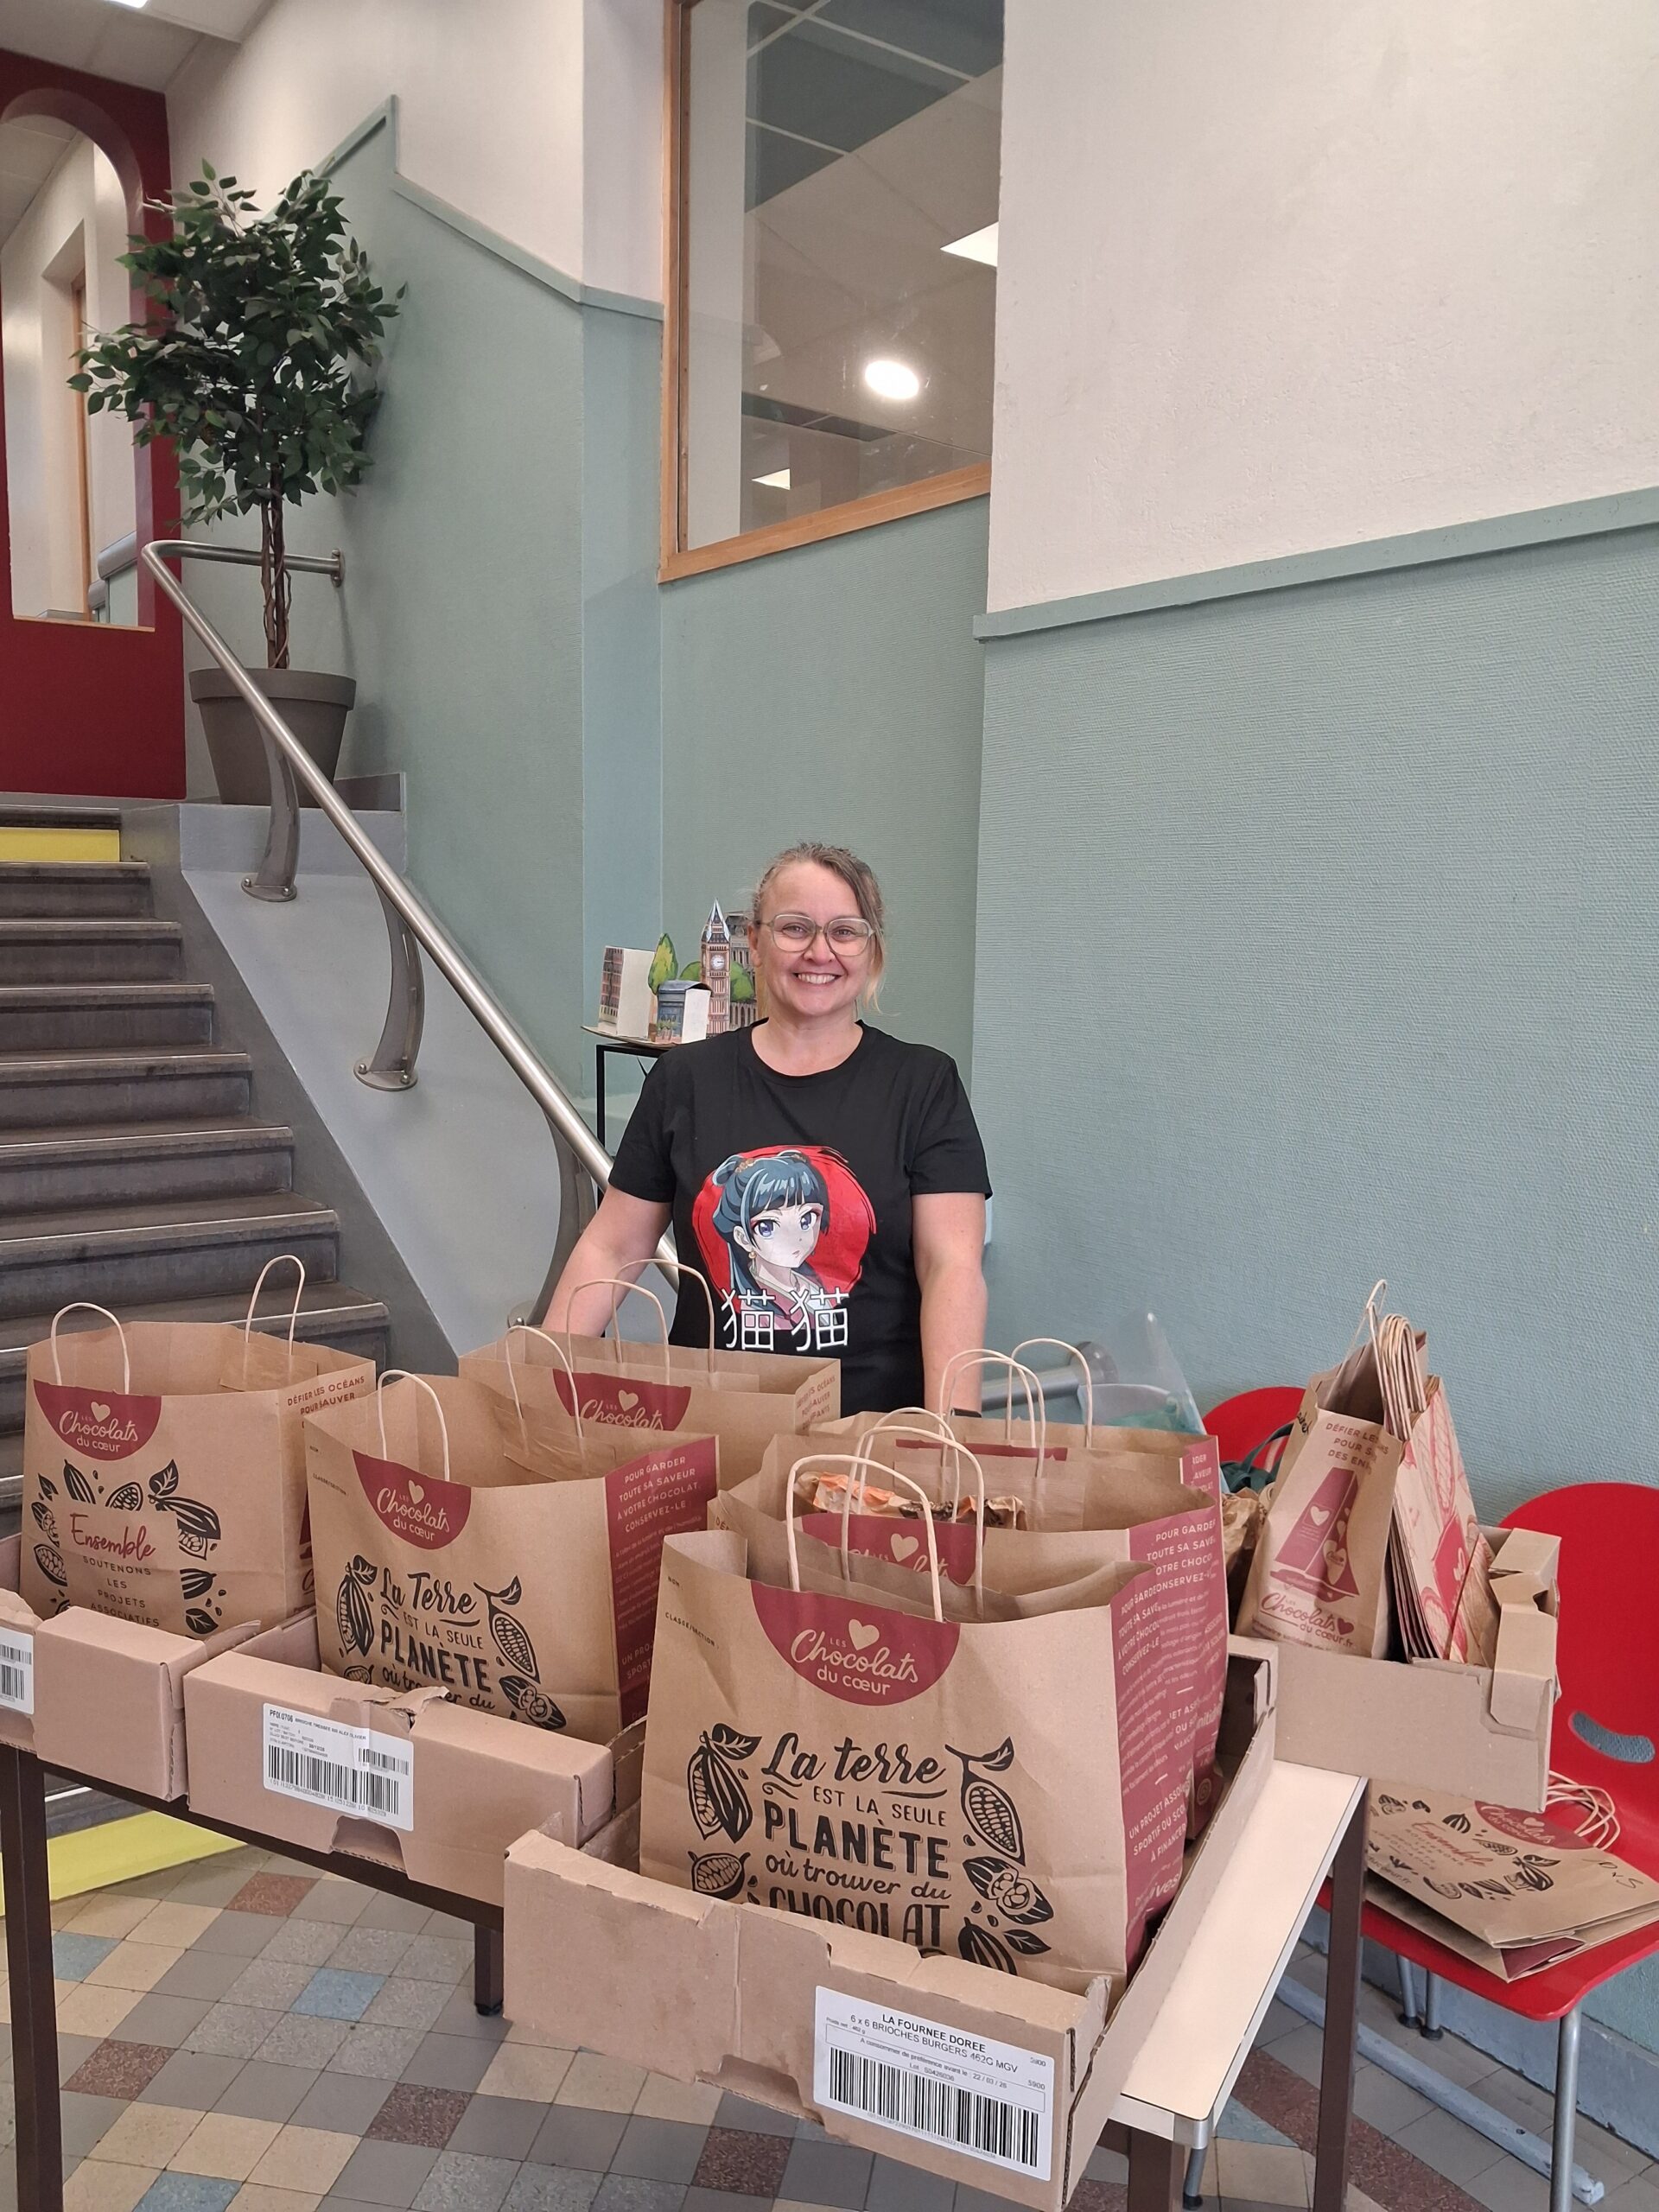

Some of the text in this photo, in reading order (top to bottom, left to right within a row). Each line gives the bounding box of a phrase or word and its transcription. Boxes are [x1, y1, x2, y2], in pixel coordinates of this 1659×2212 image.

[721, 1287, 849, 1351] 猫猫
[287, 1376, 365, 1406] DÉFIER LES OCÉANS
[300, 1392, 355, 1415] POUR SAUVER
[60, 1410, 138, 1442] Chocolats
[581, 1399, 664, 1431] Chocolats
[1325, 1422, 1361, 1438] DÉFIER
[76, 1436, 121, 1452] du cœur
[1328, 1450, 1348, 1461] DES
[1333, 1438, 1363, 1452] POUR
[619, 1468, 696, 1503] TOUTE SA SAVEUR
[625, 1456, 686, 1484] POUR GARDER
[377, 1487, 449, 1533] Chocolats
[623, 1499, 646, 1517] VOTRE
[625, 1500, 686, 1533] CONSERVEZ-LE
[70, 1512, 156, 1560] Ensemble
[393, 1516, 435, 1541] du cœur
[1155, 1529, 1179, 1542] POUR
[1147, 1535, 1217, 1561] TOUTE SA SAVE
[83, 1555, 151, 1575] SOUTENONS
[1155, 1561, 1179, 1576] OTRE
[97, 1589, 145, 1608] PROJETS
[106, 1578, 127, 1589] LES
[380, 1567, 478, 1615] La Terre
[91, 1603, 159, 1627] ASSOCIATIFS
[1262, 1592, 1335, 1631] Chocolats
[1300, 1622, 1313, 1633] du
[404, 1611, 484, 1650] EST LA SEULE
[830, 1637, 847, 1648] LES
[380, 1618, 493, 1693] PLANÈTE
[791, 1629, 918, 1683] Chocolats
[382, 1663, 401, 1687] où
[469, 1694, 496, 1710] du
[817, 1665, 891, 1695] du cœur
[761, 1732, 947, 1788] La terre
[813, 1785, 947, 1827] EST LA SEULE
[1128, 1826, 1141, 1840] UN
[1140, 1801, 1164, 1829] PROJET
[763, 1798, 951, 1880] PLANÈTE
[1133, 1825, 1162, 1857] SPORTIF
[1161, 1816, 1173, 1832] OU
[1157, 1823, 1186, 1859] FINANCER
[766, 1849, 952, 1900] où trouver du
[850, 2014, 856, 2023] 6
[873, 2022, 919, 2043] BRIOCHES
[922, 2035, 967, 2057] BURGERS
[995, 2059, 1018, 2073] MGV
[882, 2014, 985, 2053] LA FOURNEE DOREE
[944, 2064, 961, 2075] avant
